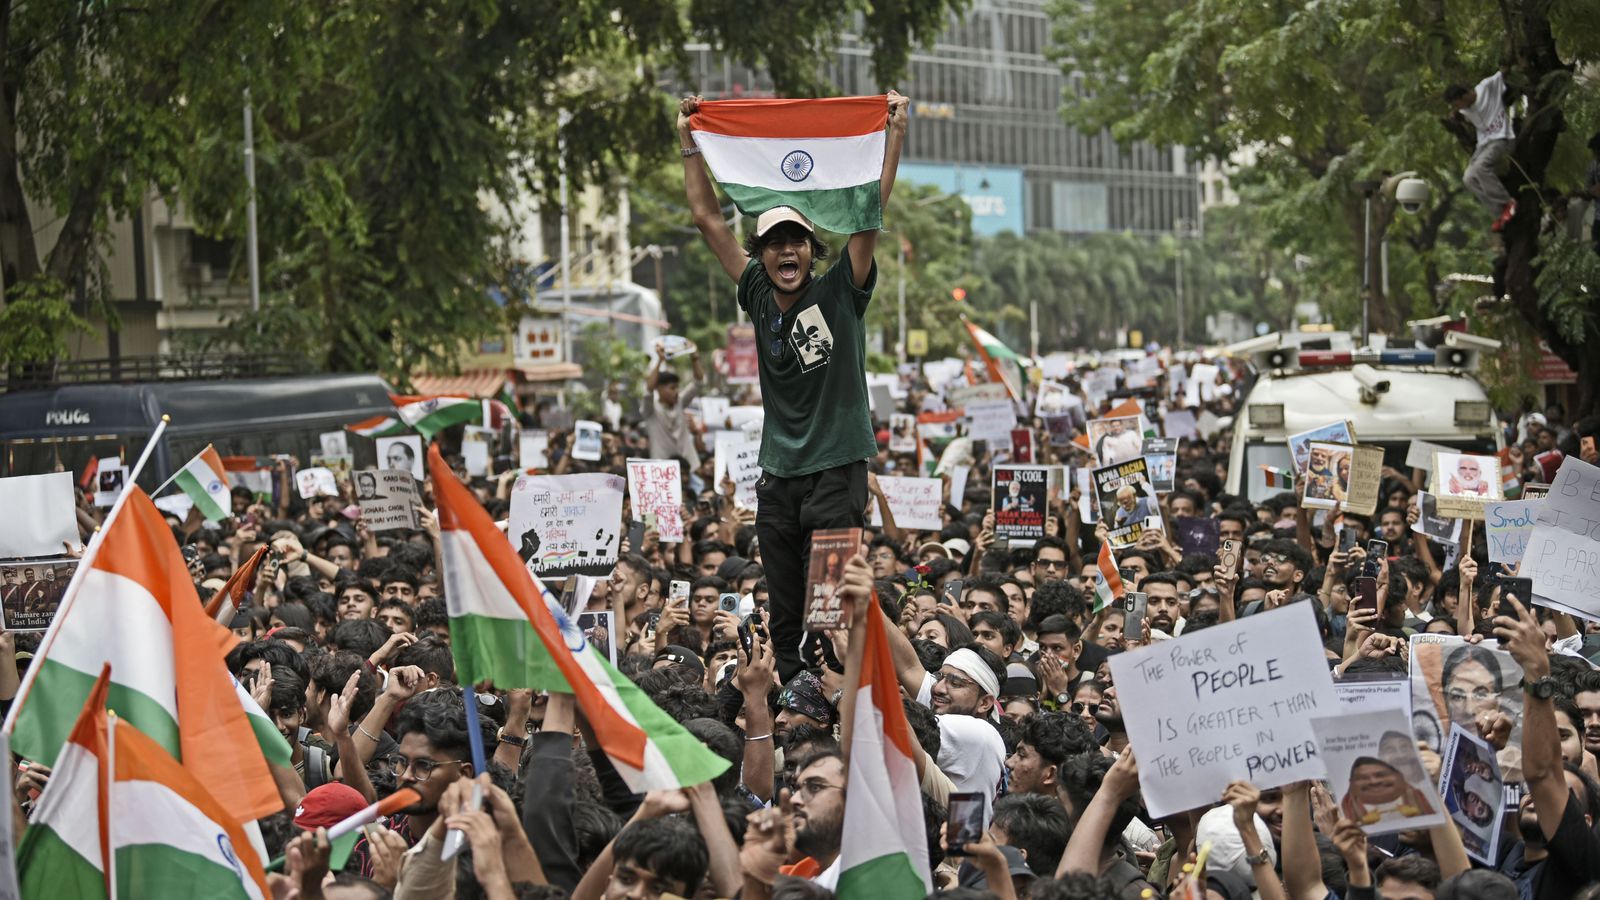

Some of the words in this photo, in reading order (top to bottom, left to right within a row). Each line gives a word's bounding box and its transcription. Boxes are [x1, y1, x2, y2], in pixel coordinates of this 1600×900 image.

[46, 409, 90, 425] POLICE
[1022, 470, 1043, 482] COOL
[1098, 468, 1119, 484] APNA
[1135, 658, 1164, 684] THE
[1170, 645, 1217, 670] POWER
[1192, 658, 1283, 700] PEOPLE
[1158, 718, 1178, 743] IS
[1187, 706, 1264, 736] GREATER
[1270, 690, 1318, 719] THAN
[1151, 755, 1183, 778] THE
[1190, 743, 1243, 769] PEOPLE
[1256, 729, 1274, 747] IN
[1246, 740, 1318, 779] POWER
[1443, 732, 1458, 780] Accountability
[1503, 784, 1520, 805] hi
